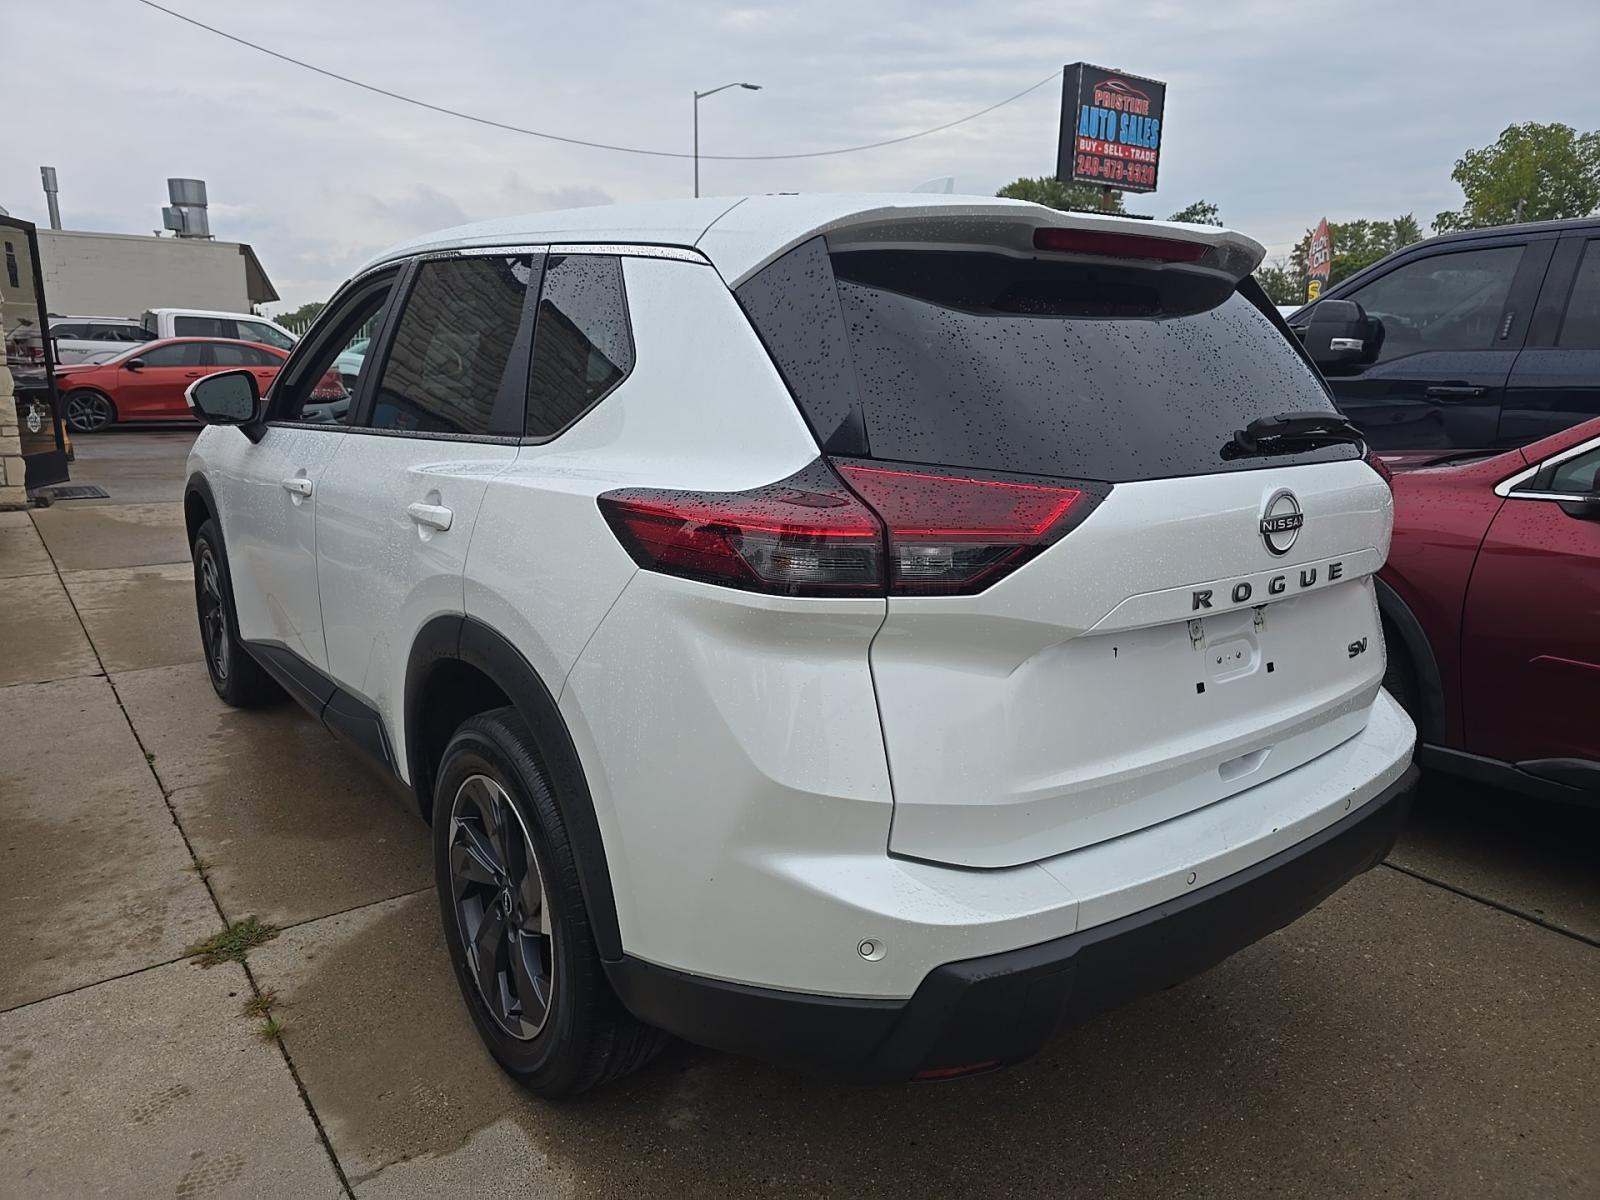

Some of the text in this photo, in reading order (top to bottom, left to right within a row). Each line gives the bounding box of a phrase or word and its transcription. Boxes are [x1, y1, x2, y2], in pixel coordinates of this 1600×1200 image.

[1095, 89, 1149, 116] PRISTINE
[1078, 105, 1160, 149] AUTO SALES
[1079, 138, 1156, 162] BUY SELL TRADE
[1263, 515, 1303, 531] NISSAN
[1192, 562, 1343, 611] ROGUE
[1348, 637, 1368, 659] SV
